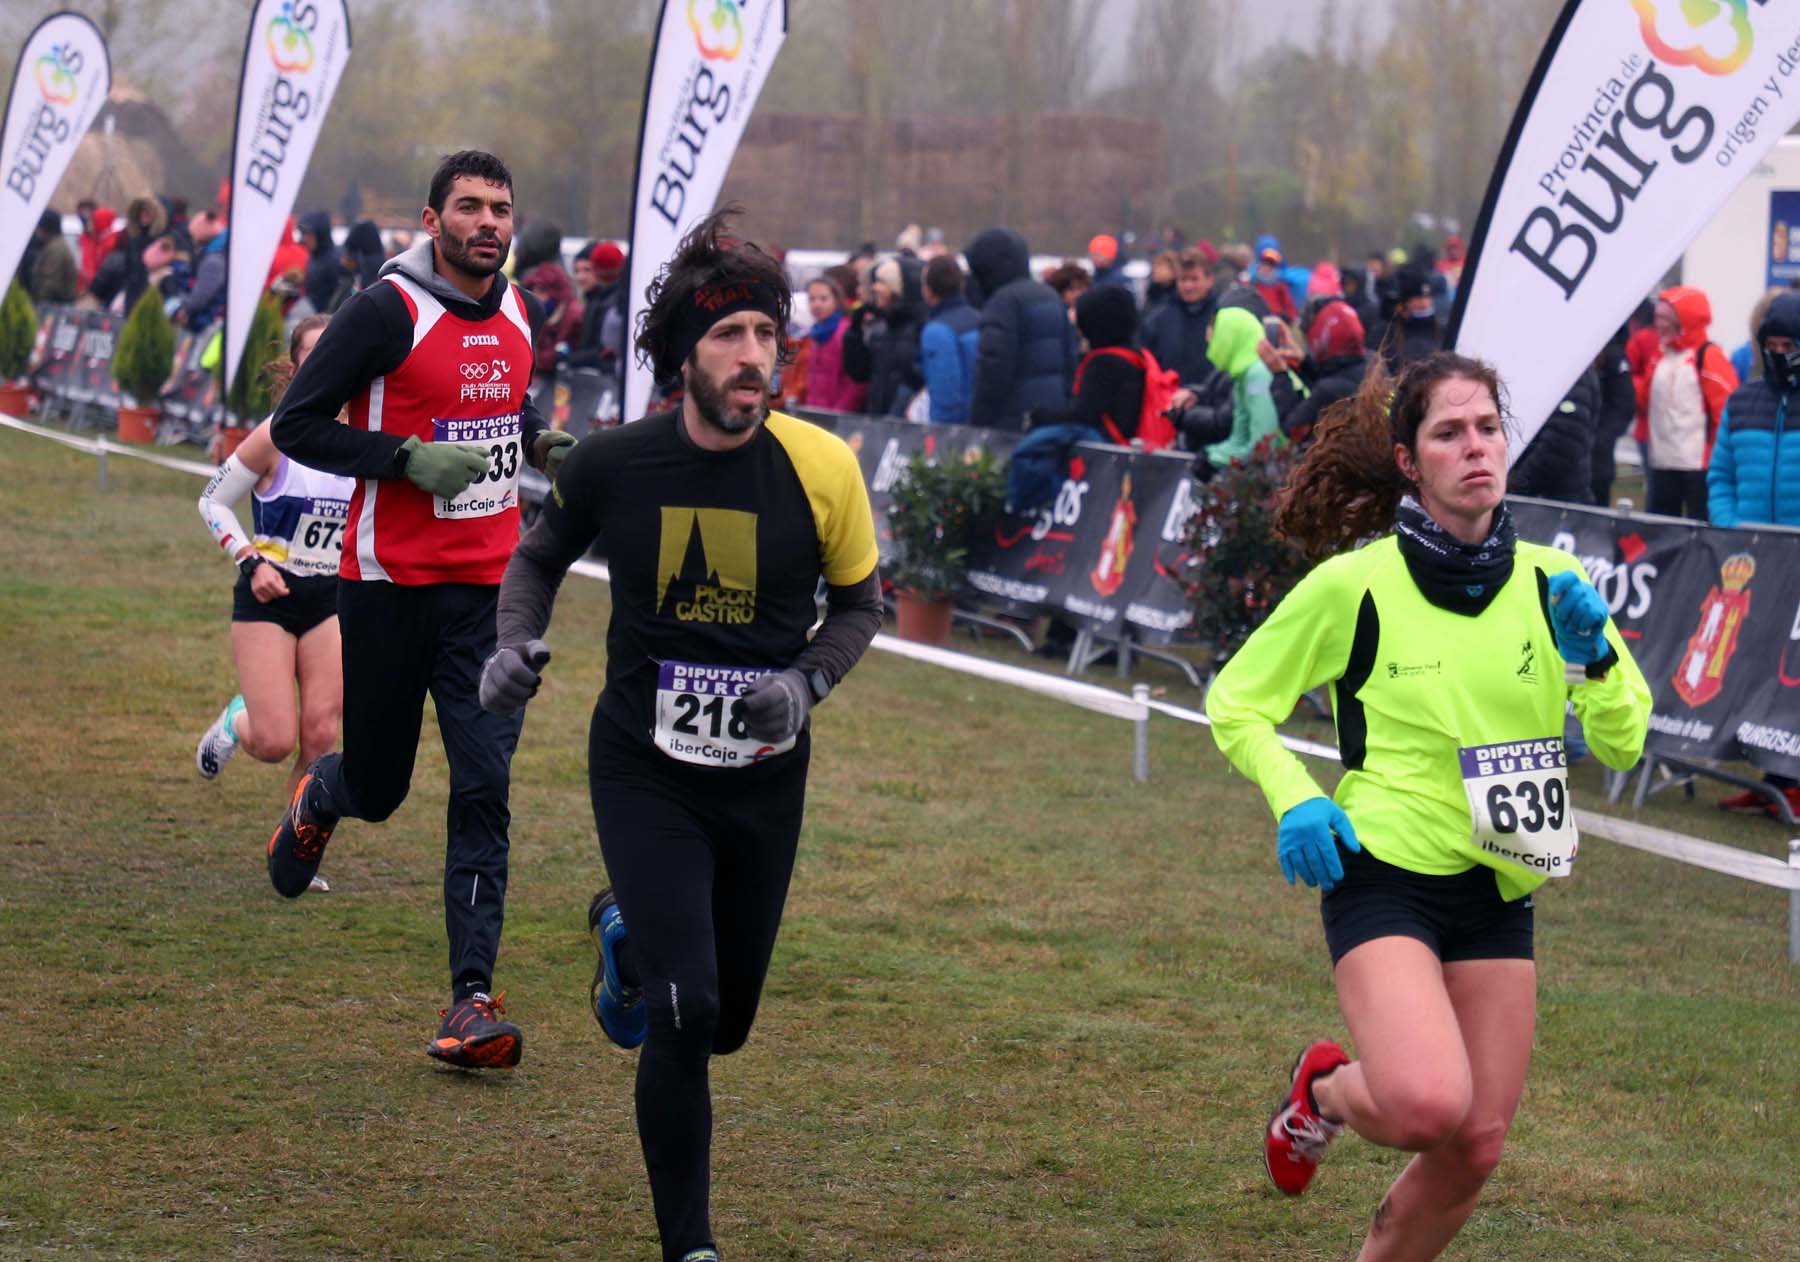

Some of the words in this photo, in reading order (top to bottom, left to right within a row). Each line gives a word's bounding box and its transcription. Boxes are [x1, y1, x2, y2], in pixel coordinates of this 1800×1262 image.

[1538, 76, 1625, 197] Provincia
[1621, 52, 1644, 81] de
[1715, 96, 1769, 168] origen
[1764, 76, 1783, 99] y
[461, 388, 511, 399] PETRER
[447, 414, 520, 431] DIPUTACIÓN
[448, 426, 520, 441] BURGOS
[442, 498, 496, 513] iberCaja
[675, 601, 755, 624] CASTRO
[670, 738, 738, 763] iberCaja
[1487, 777, 1565, 834] 639
[1481, 840, 1561, 872] iberCaja
